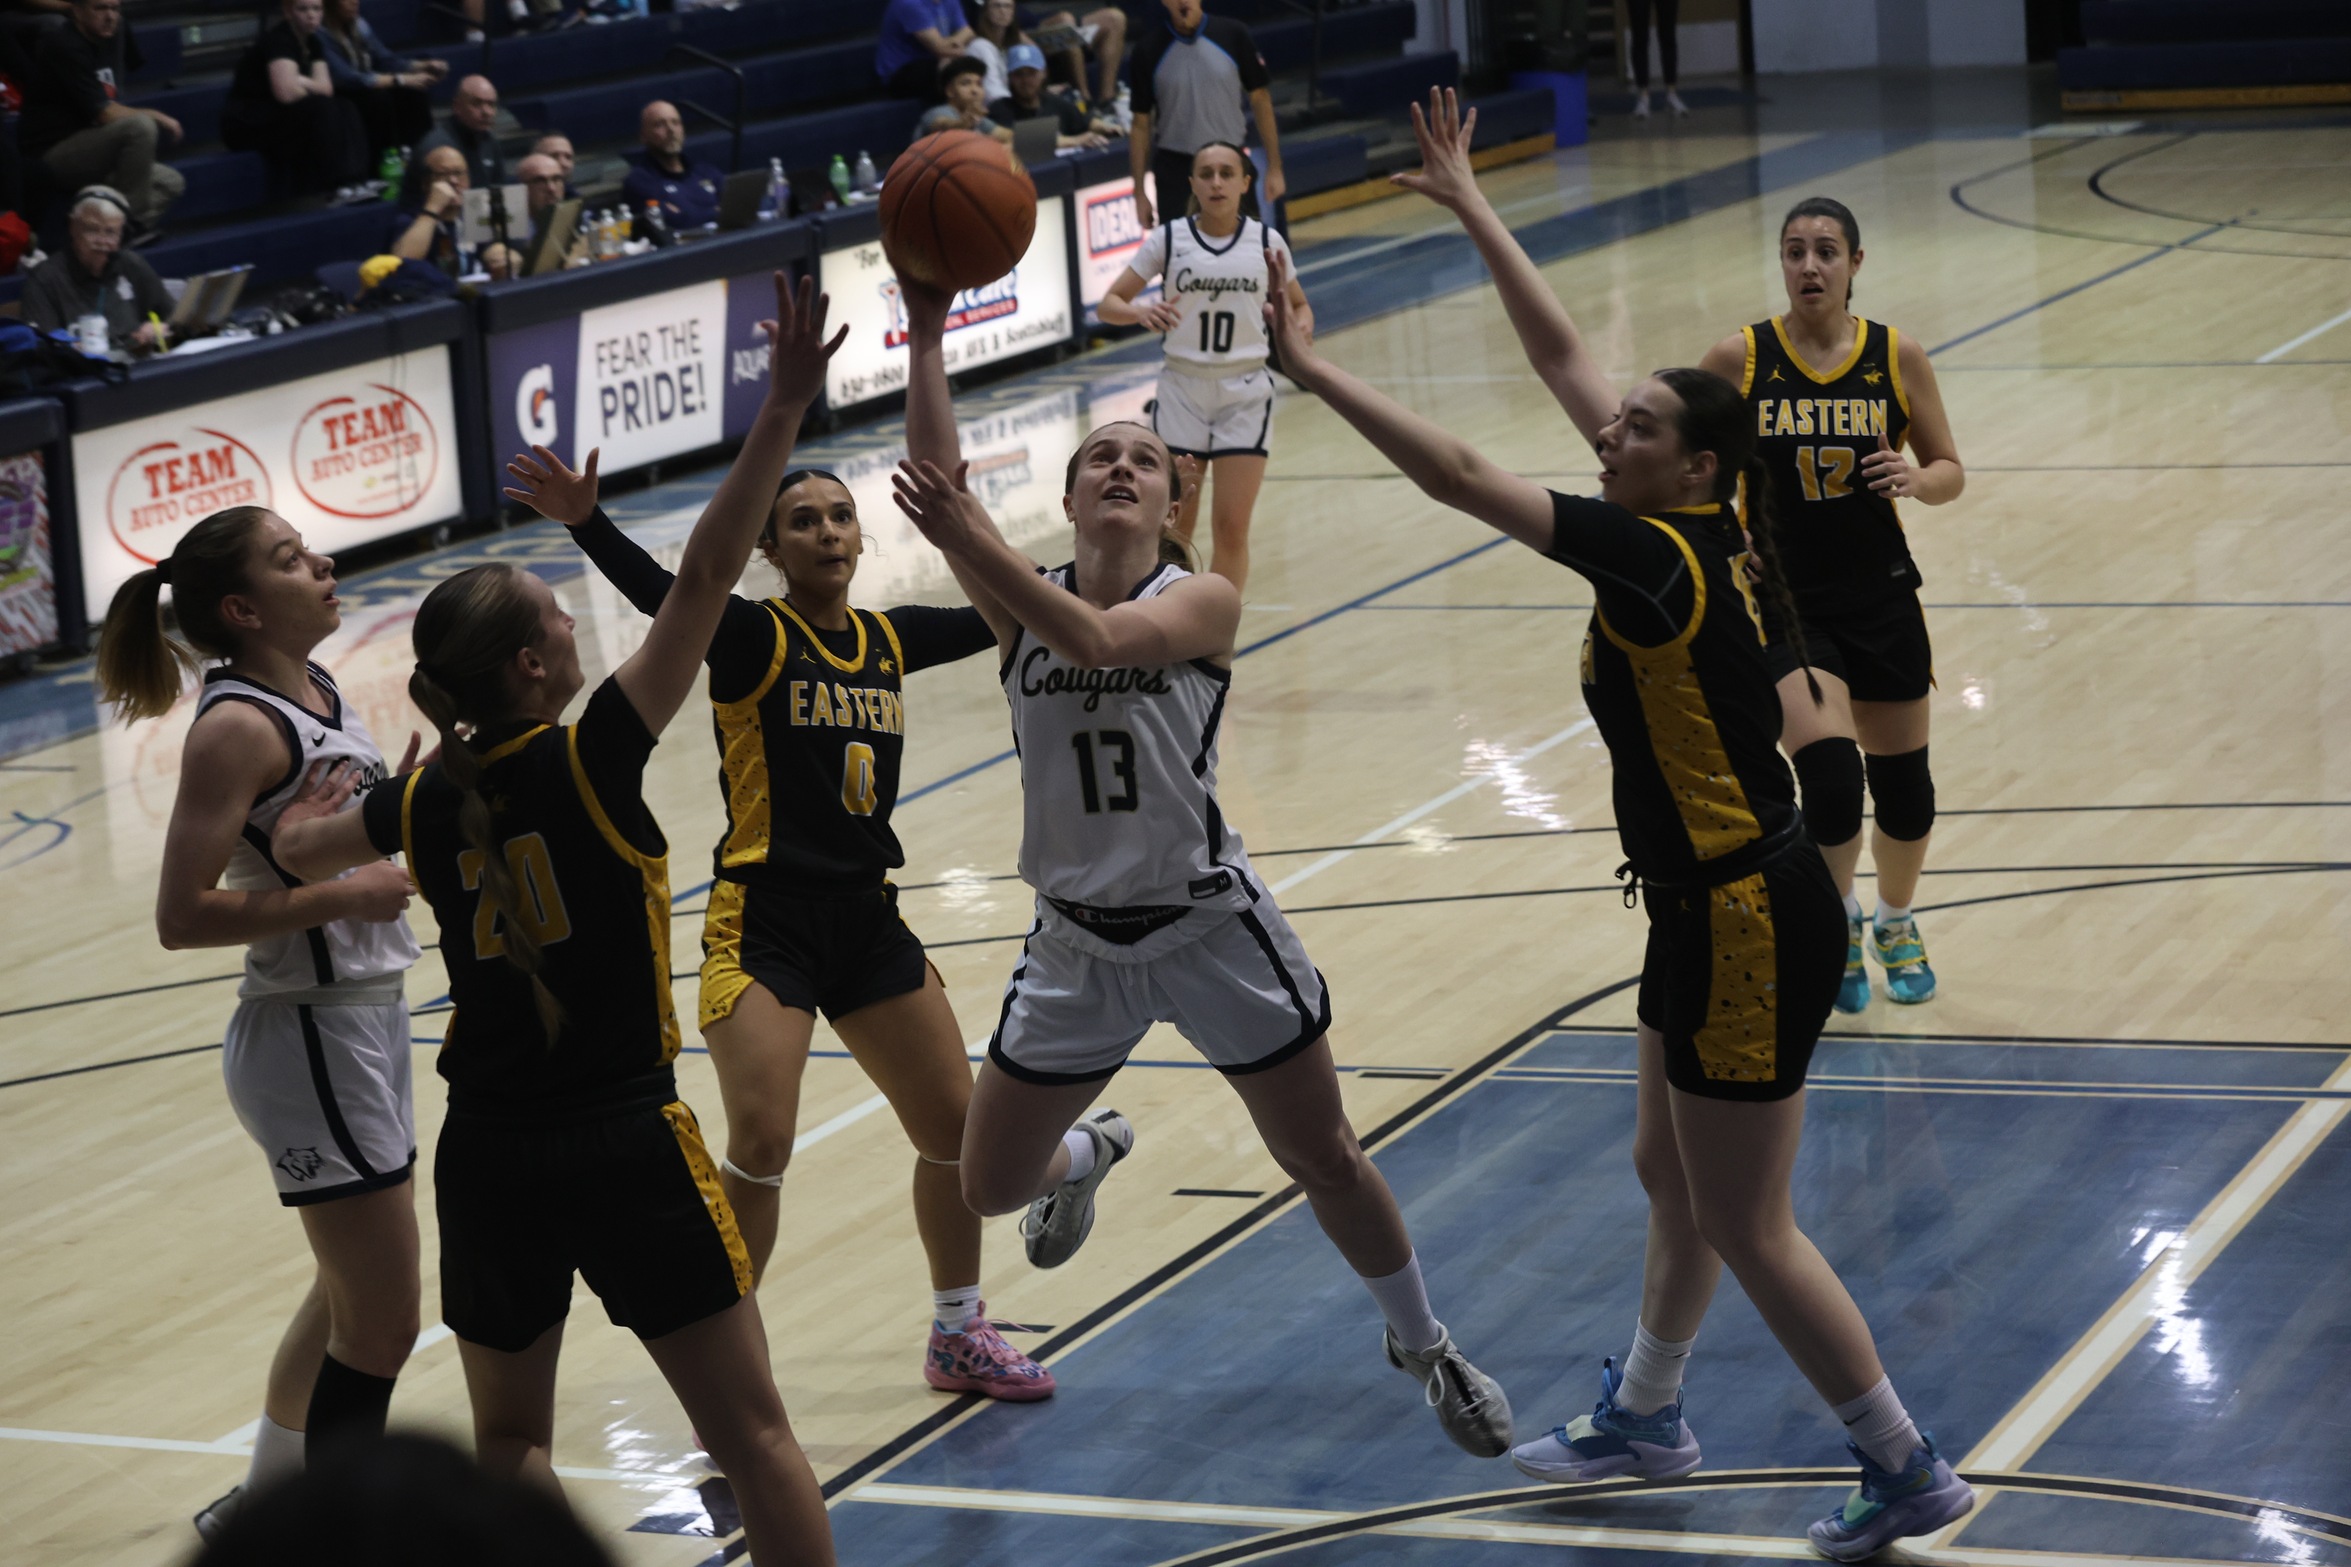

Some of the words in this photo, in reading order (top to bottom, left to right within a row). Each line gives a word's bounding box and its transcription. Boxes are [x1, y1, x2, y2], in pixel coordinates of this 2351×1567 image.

[1176, 267, 1260, 302] Cougars
[596, 337, 652, 379] FEAR
[658, 319, 702, 362] THE
[1198, 311, 1236, 353] 10
[321, 400, 406, 451] TEAM
[600, 362, 707, 438] PRIDE!
[1758, 399, 1887, 437] EASTERN
[142, 445, 237, 499] TEAM
[311, 450, 357, 482] AUTO
[358, 432, 424, 472] CENTER
[1796, 446, 1855, 501] 12
[130, 496, 180, 532] AUTO
[184, 478, 258, 518] CENTER
[1020, 646, 1171, 713] Cougars
[790, 680, 904, 737] EASTERN
[841, 741, 878, 817] 0
[1071, 729, 1139, 815] 13
[457, 831, 572, 960] 20
[1219, 877, 1228, 887] M
[1075, 905, 1185, 926] Champion
